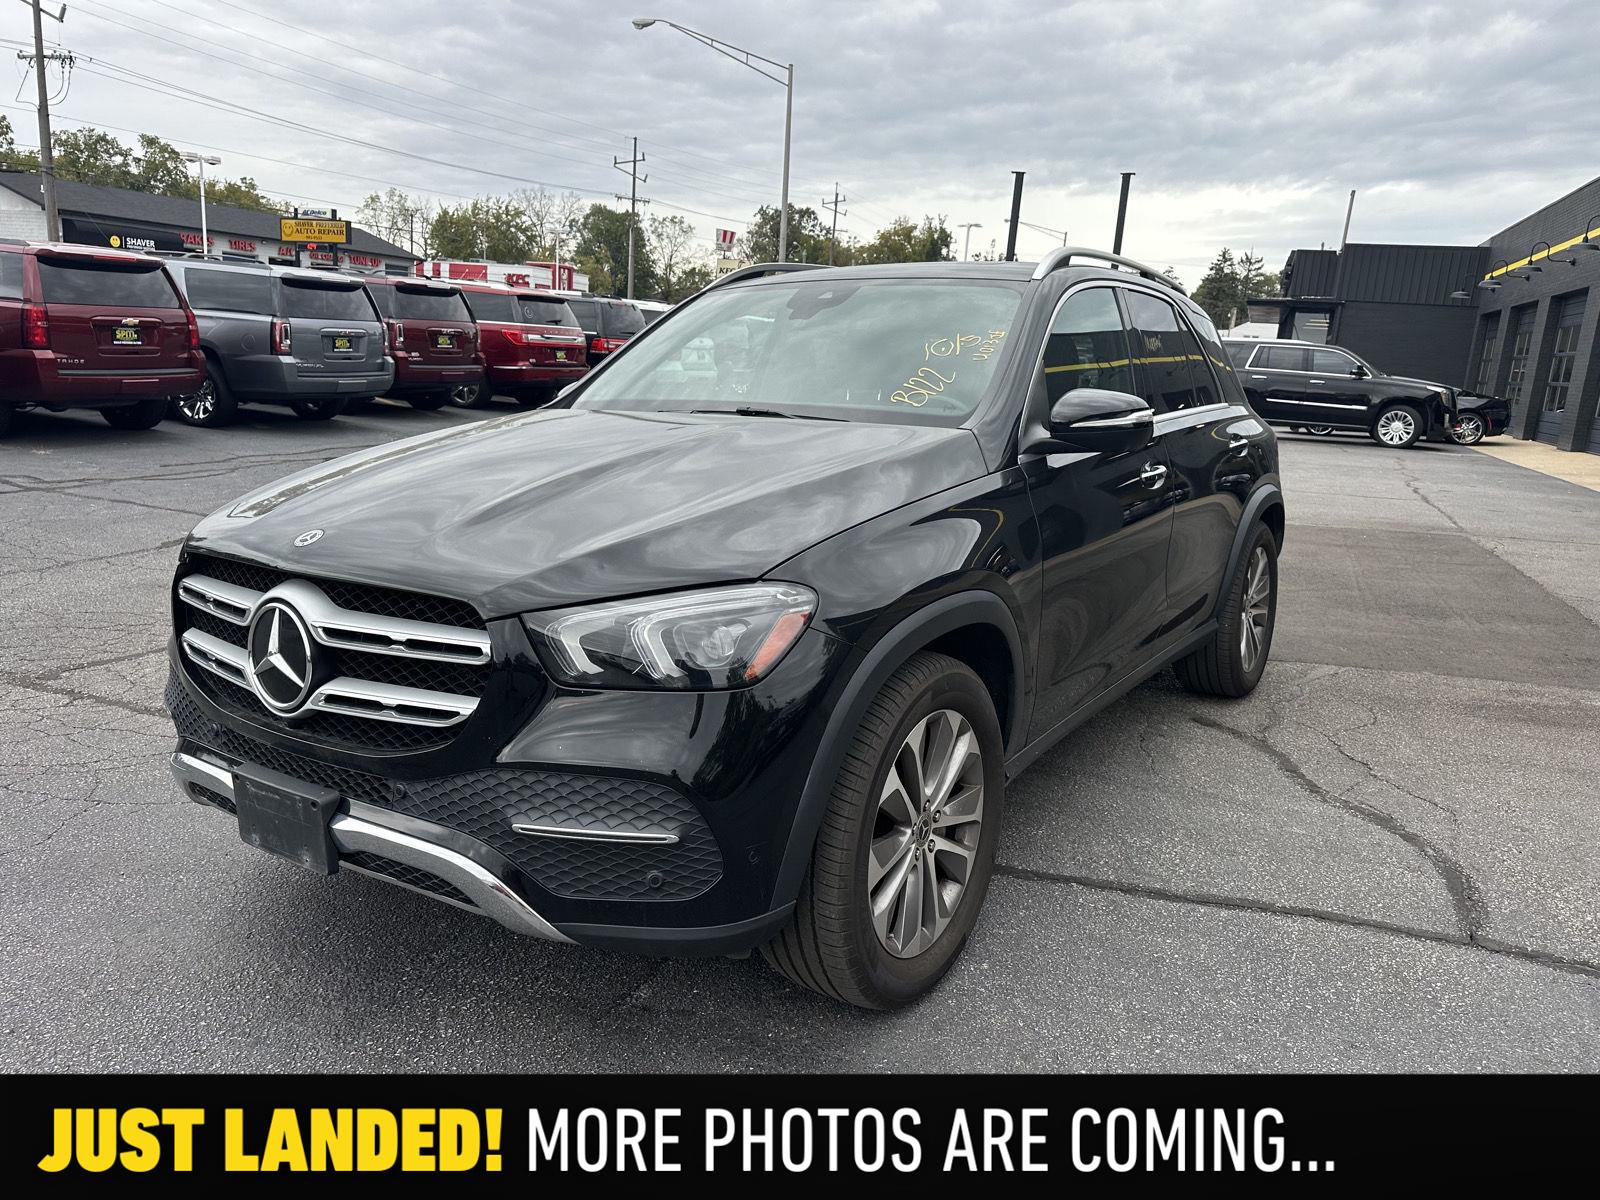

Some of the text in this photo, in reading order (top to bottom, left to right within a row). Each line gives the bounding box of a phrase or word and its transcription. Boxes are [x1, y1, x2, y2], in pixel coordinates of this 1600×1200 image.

[126, 237, 155, 248] SHAVER
[228, 239, 257, 252] TIRES
[889, 367, 957, 408] B122
